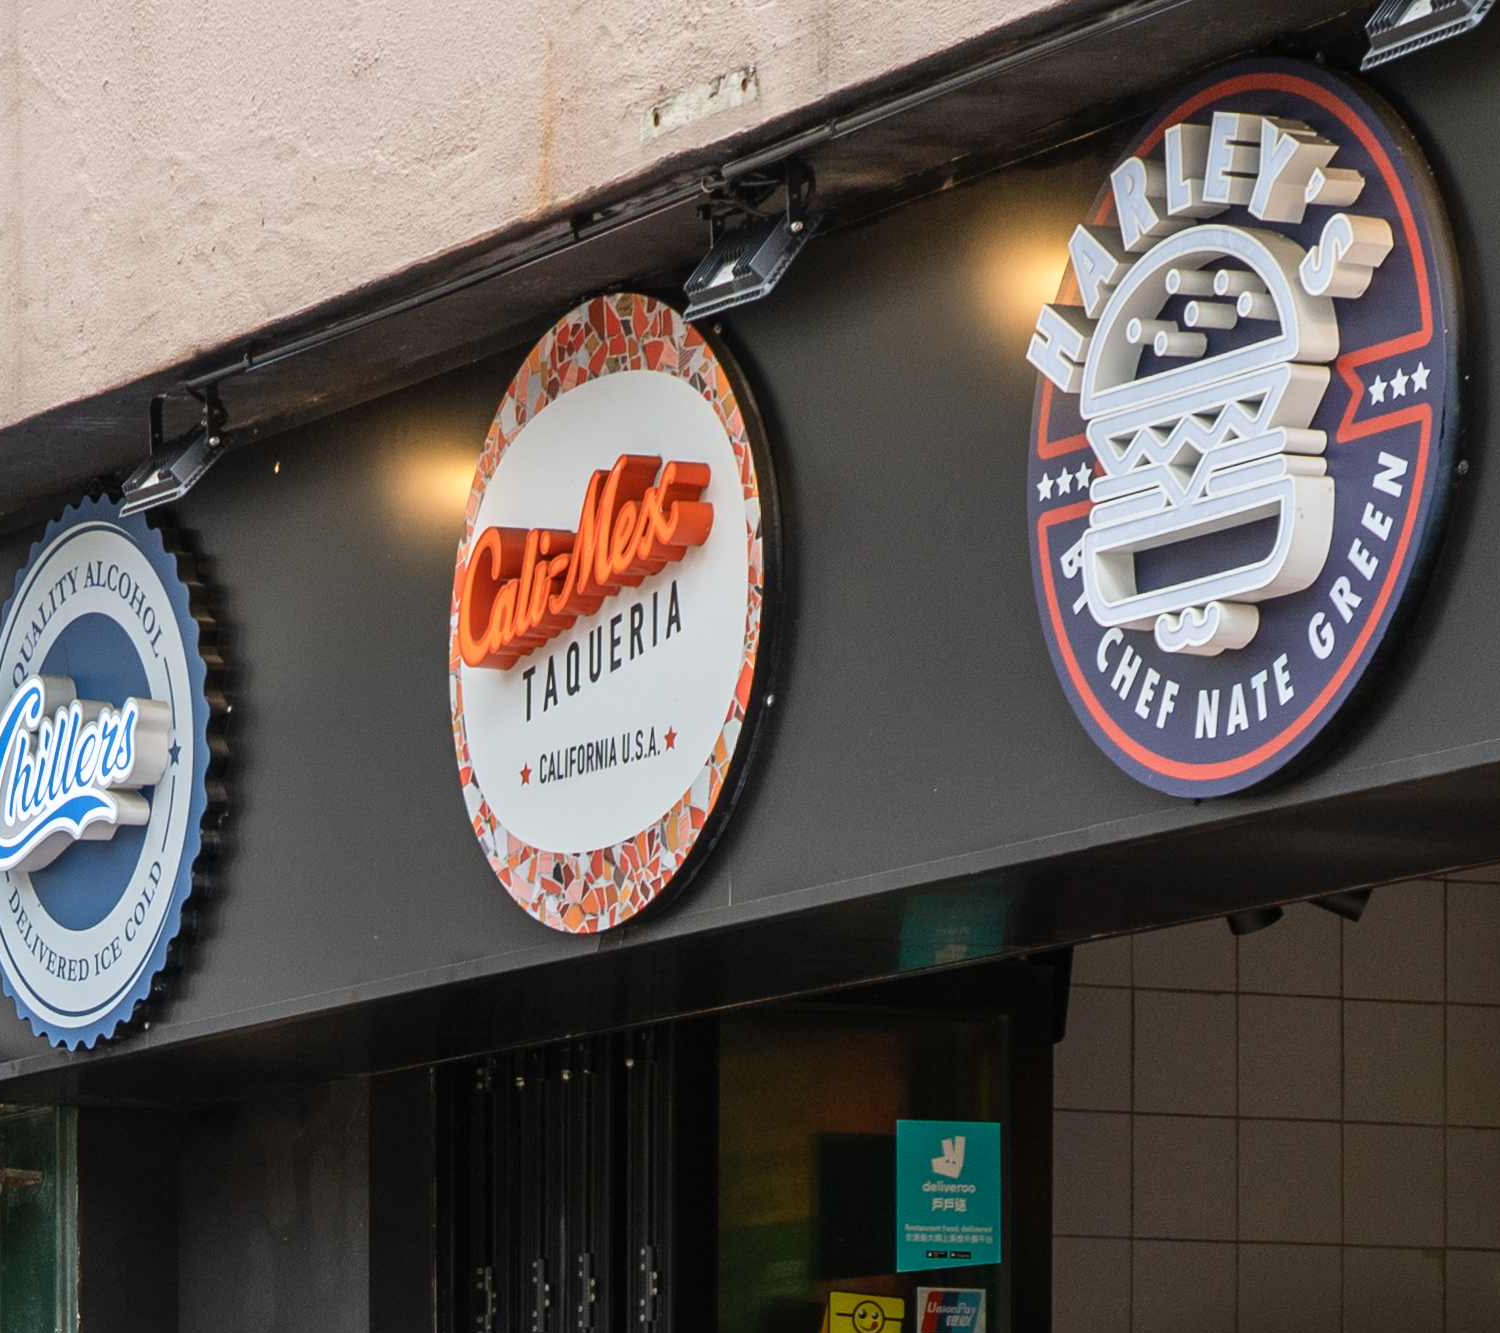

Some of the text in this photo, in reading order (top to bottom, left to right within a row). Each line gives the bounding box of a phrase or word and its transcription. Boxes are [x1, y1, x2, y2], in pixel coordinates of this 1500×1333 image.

[1027, 110, 1394, 396] HARLEY'S
[12, 560, 162, 688] QUALITY ALCOHOL
[458, 455, 712, 669] Cali-Mex
[1096, 452, 1409, 740] CHEF NATE GREEN
[522, 580, 682, 723] TAQUERIA
[539, 726, 661, 785] CALIFORNIA U.S.A.
[8, 860, 163, 983] DELIVERED ICE COLD
[922, 1181, 976, 1194] deliveroo
[926, 1301, 977, 1316] UnionPay
